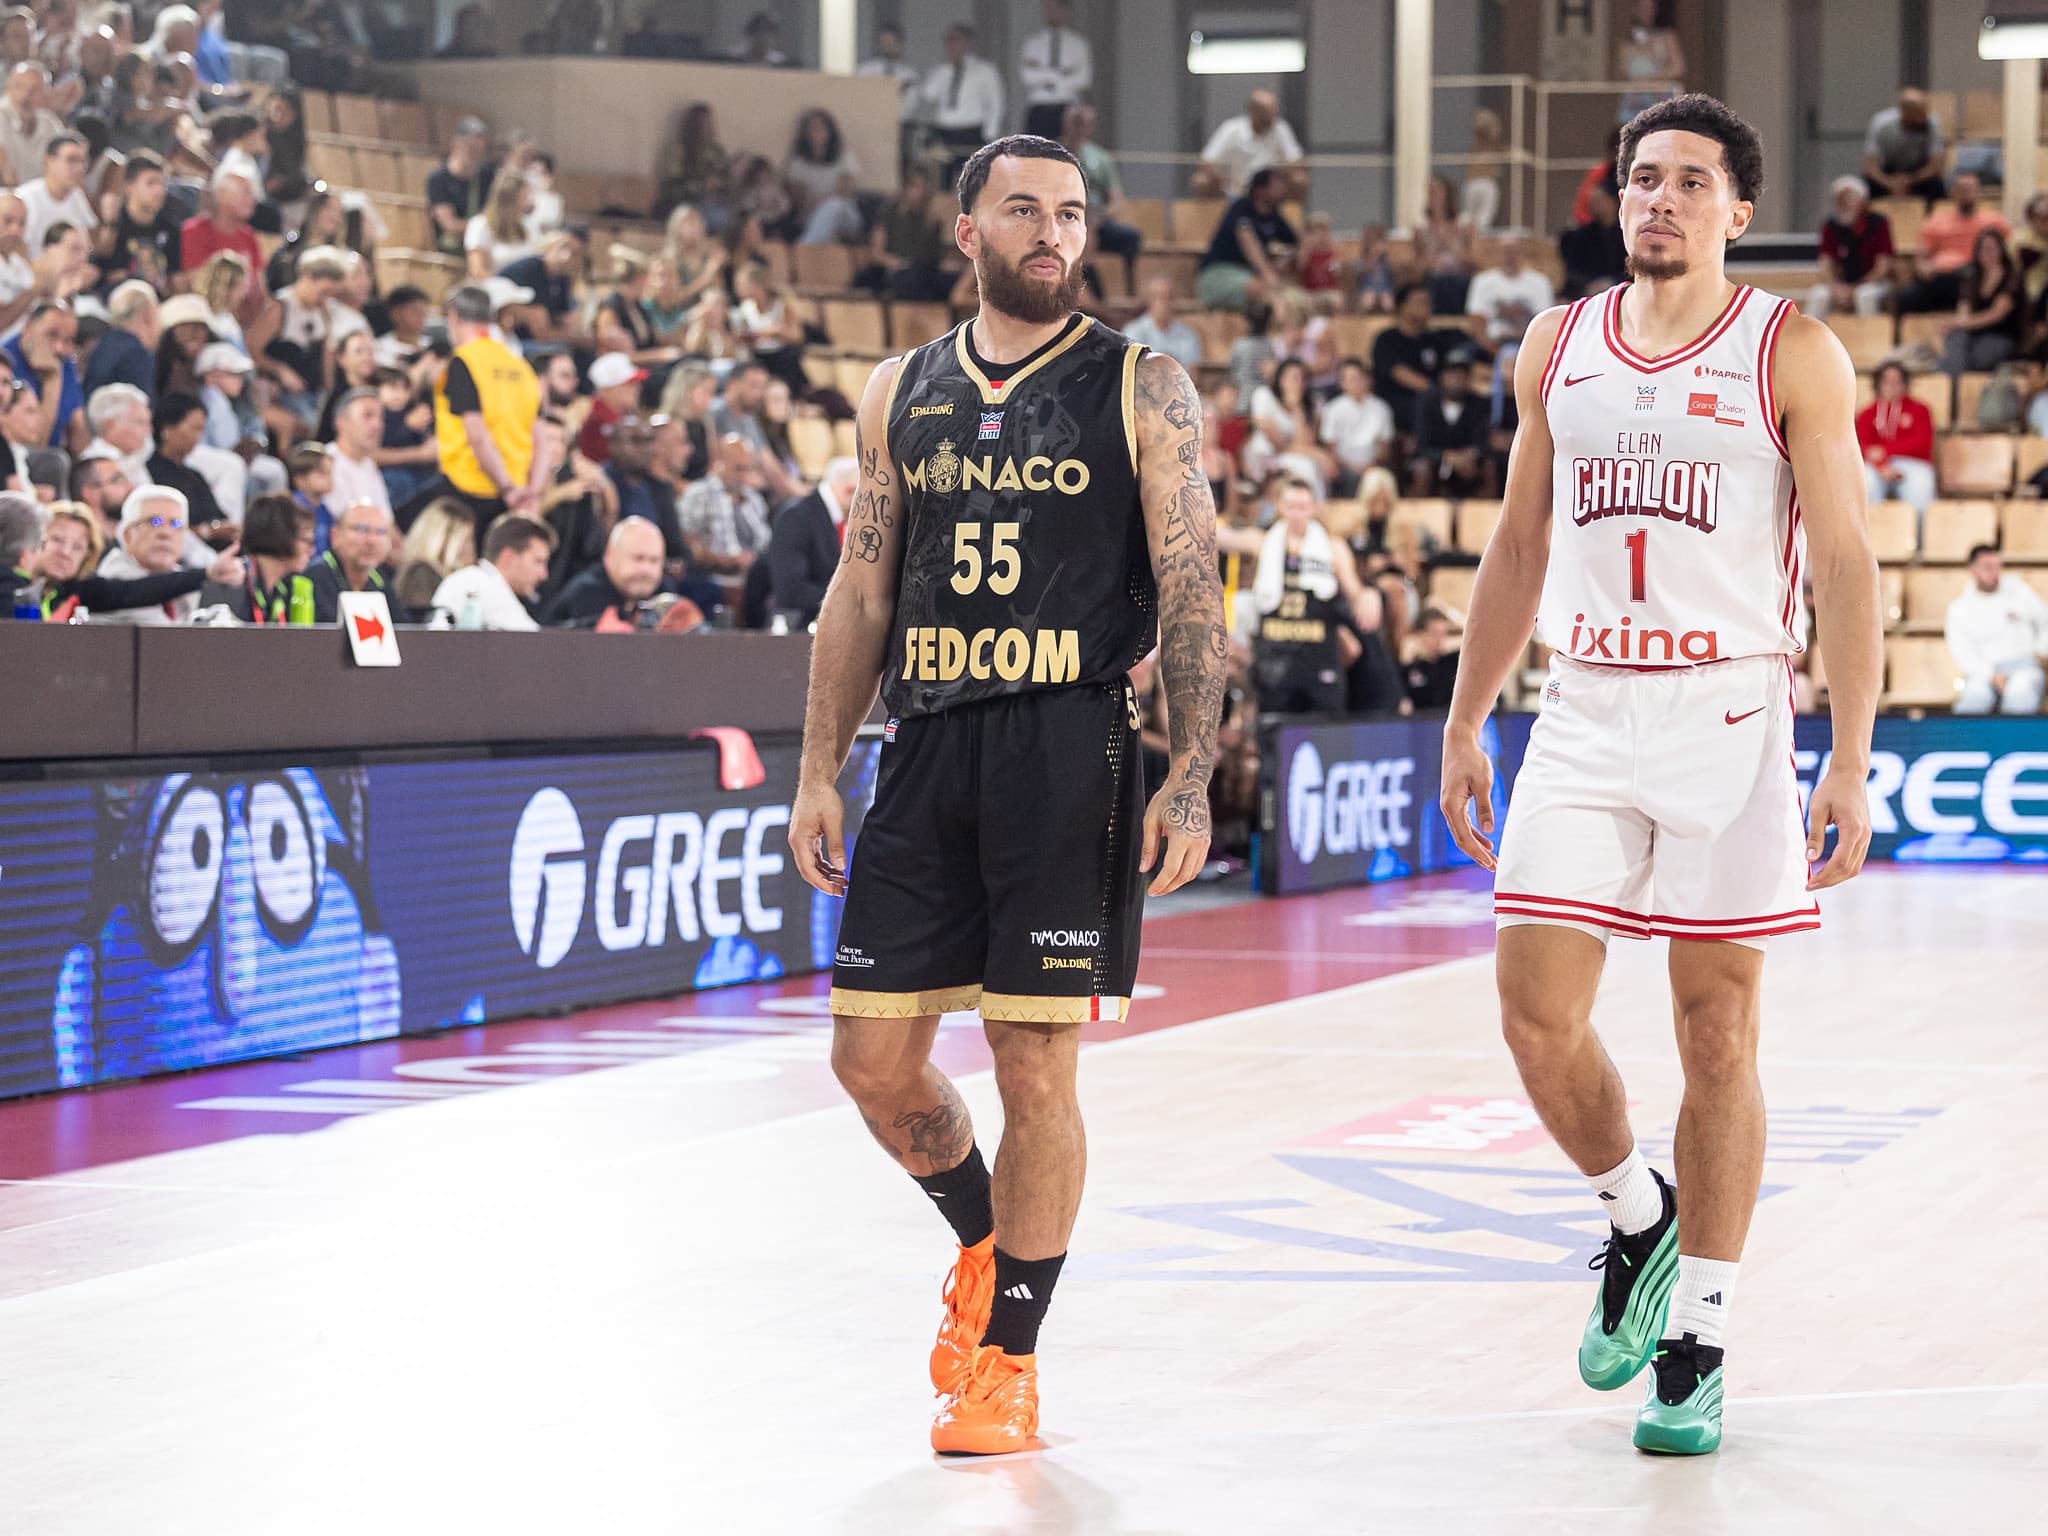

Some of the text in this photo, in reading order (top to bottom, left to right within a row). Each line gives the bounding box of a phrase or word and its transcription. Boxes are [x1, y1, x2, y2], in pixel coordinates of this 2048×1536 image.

[1711, 369, 1751, 383] PAPREC
[909, 403, 954, 419] SPALDING
[1617, 432, 1662, 455] ELAN
[1572, 457, 1721, 534] CHALON
[950, 522, 1022, 596] 55
[1624, 528, 1648, 603] 1
[901, 627, 1081, 683] FEDCOM
[1569, 613, 1718, 661] ixina
[1325, 757, 1415, 855] GREE
[595, 804, 791, 951] GREE
[1042, 956, 1092, 971] SPALDING
